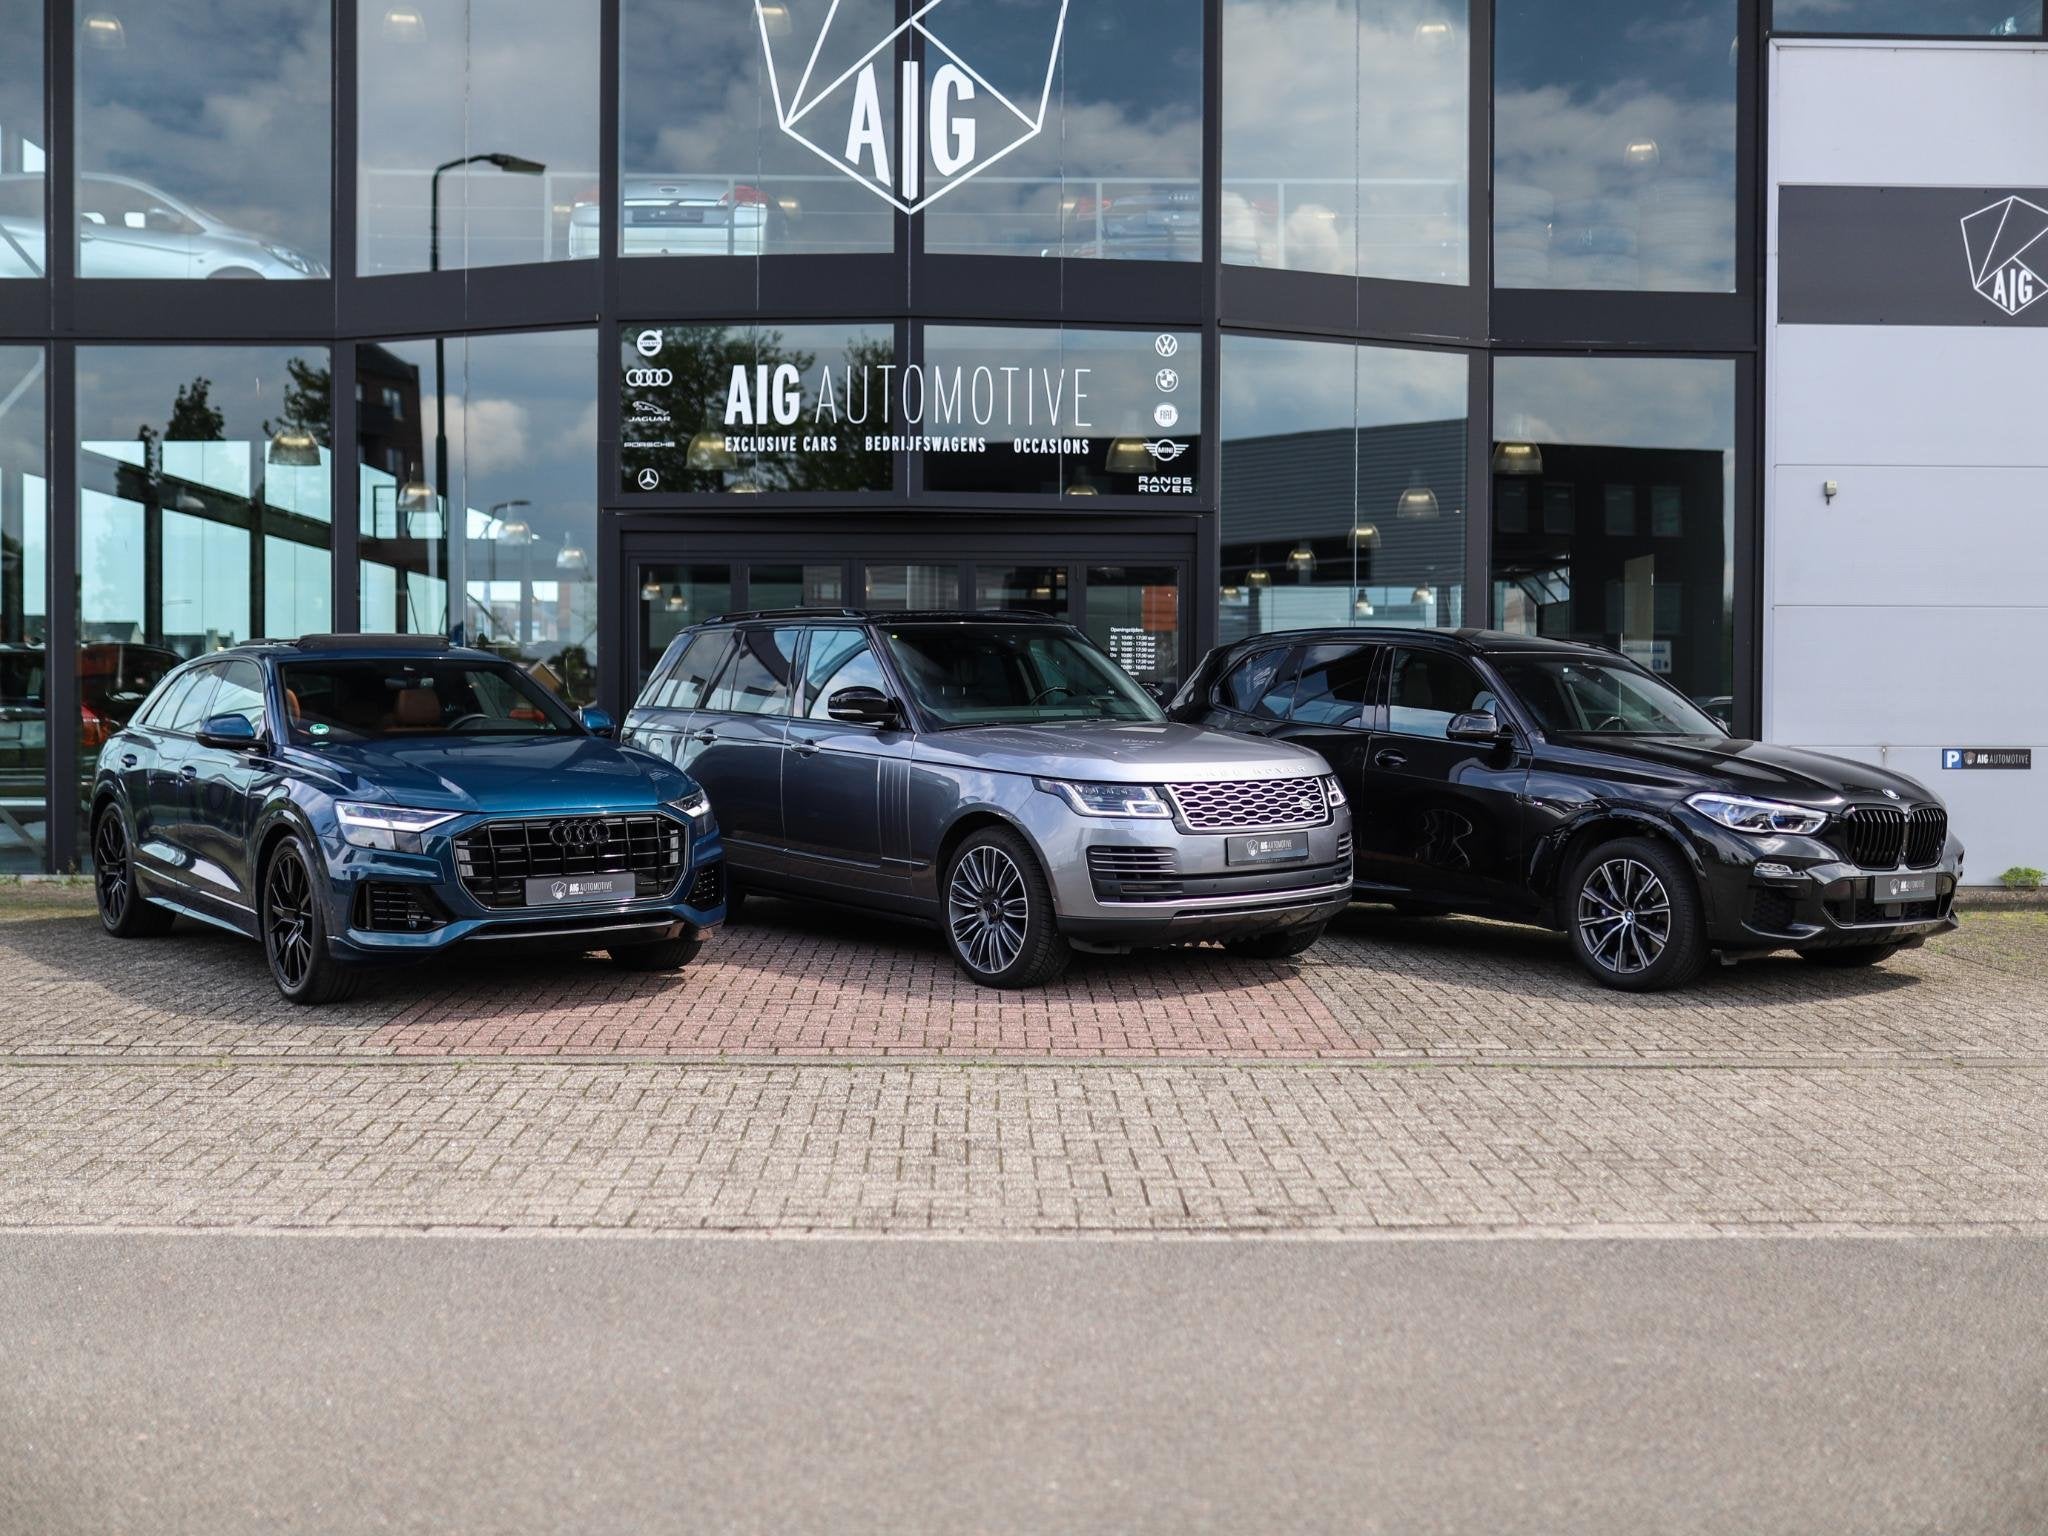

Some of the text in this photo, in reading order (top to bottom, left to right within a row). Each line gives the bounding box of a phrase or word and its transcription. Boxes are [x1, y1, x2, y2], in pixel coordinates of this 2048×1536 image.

[845, 61, 975, 200] AIG
[1993, 268, 2032, 311] AIG
[724, 363, 1092, 427] AIG AUTOMOTIVE
[724, 436, 1089, 454] EXCLUSIVE CARS BEDRIJFSWAGENS OCCASIONS
[1157, 446, 1174, 454] MINI
[1138, 476, 1192, 485] RANGE
[1138, 485, 1193, 493] ROVER
[1946, 750, 1960, 768] P
[1977, 754, 1989, 764] AIG
[1989, 754, 2029, 764] AUTOMOTIVE
